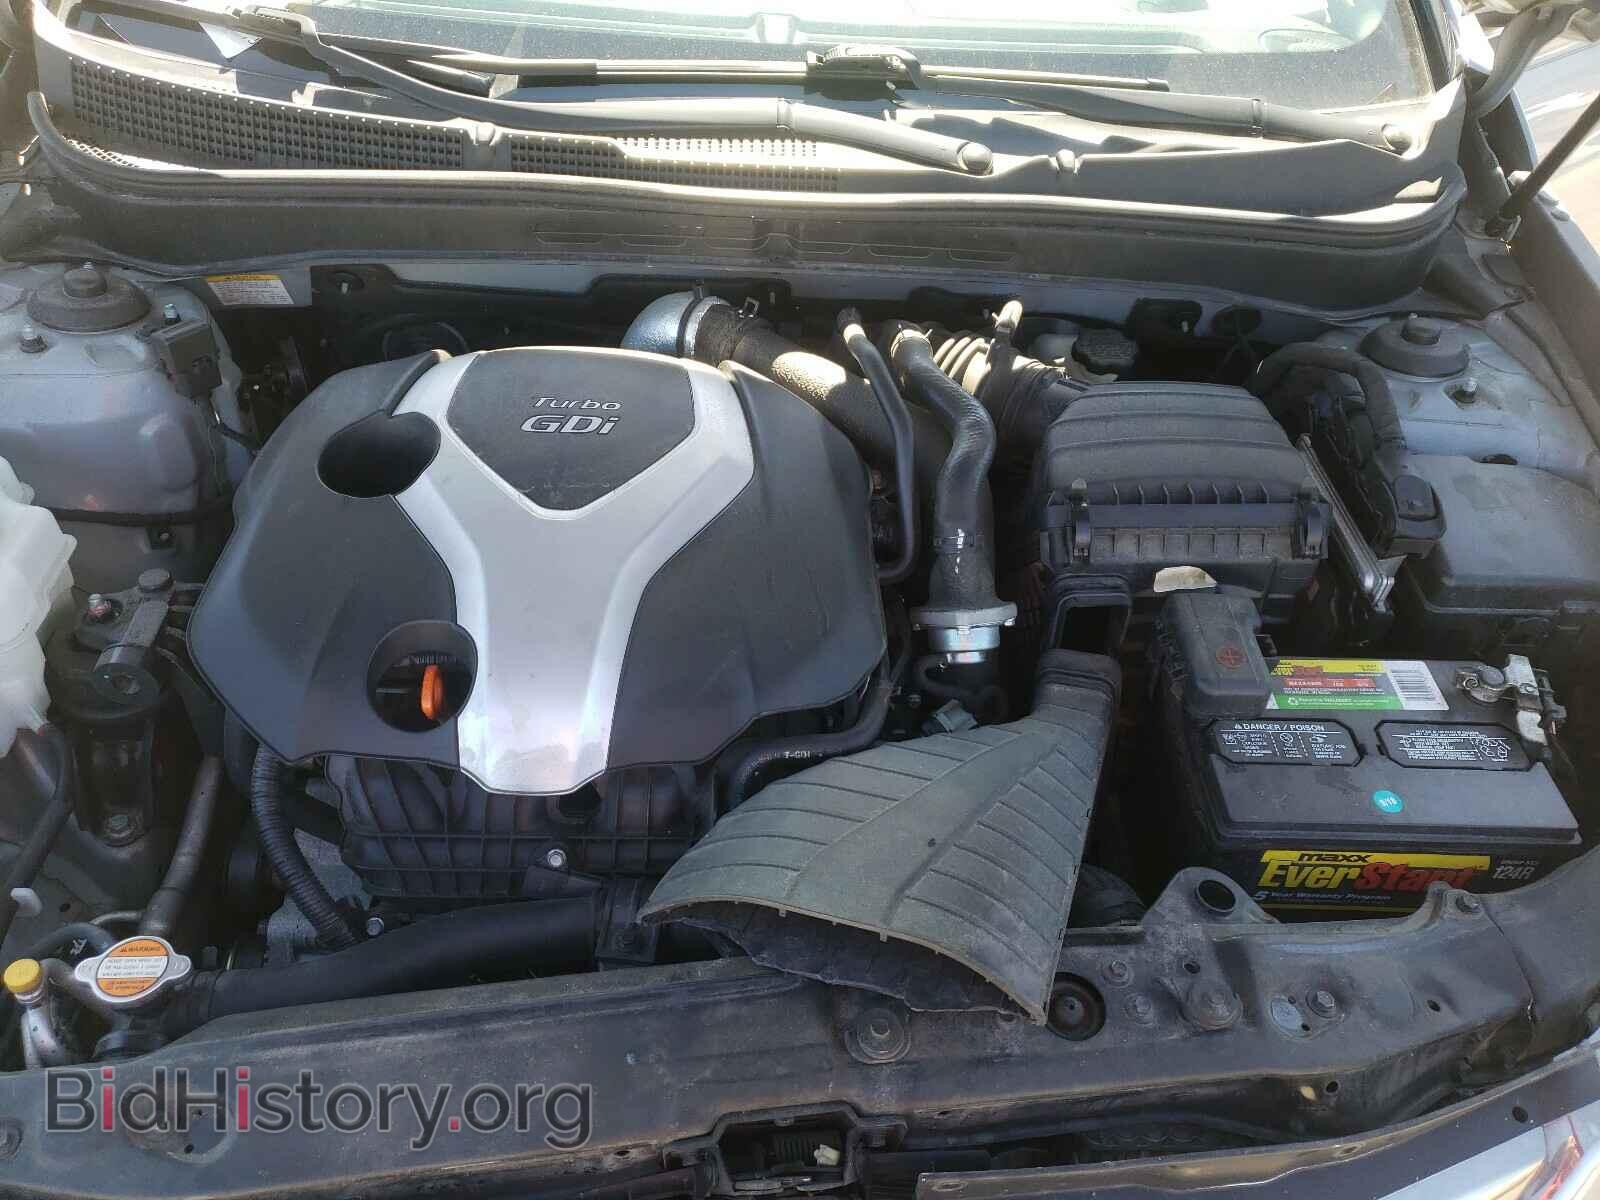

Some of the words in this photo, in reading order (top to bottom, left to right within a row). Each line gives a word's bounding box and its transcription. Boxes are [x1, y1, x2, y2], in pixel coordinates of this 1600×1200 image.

[534, 397, 621, 410] Turbo
[520, 414, 620, 435] GDi
[1242, 723, 1280, 732] DANGER
[1289, 724, 1325, 732] POISON
[1299, 853, 1372, 864] maxx
[1492, 865, 1536, 880] 124R
[1252, 890, 1270, 901] 5
